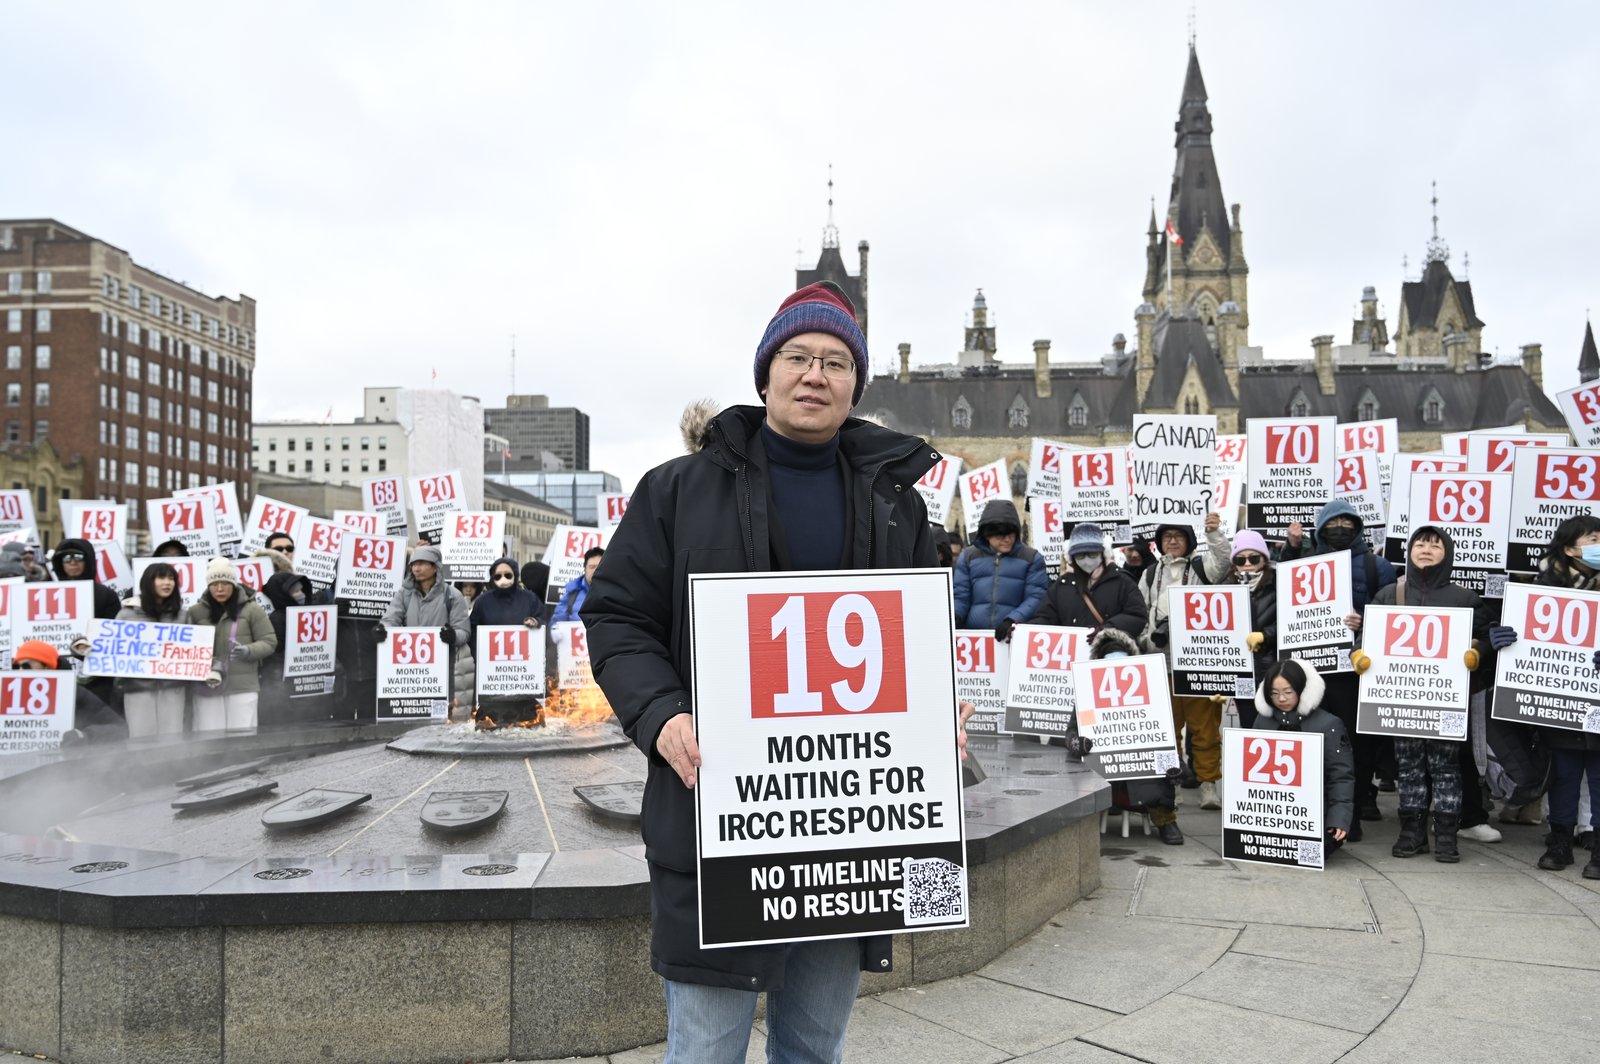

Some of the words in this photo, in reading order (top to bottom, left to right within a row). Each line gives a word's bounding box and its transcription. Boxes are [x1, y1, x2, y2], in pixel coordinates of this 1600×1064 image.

[1134, 422, 1216, 451] CANADA
[1272, 425, 1314, 464] 70
[1077, 453, 1108, 487] 13
[1134, 460, 1180, 486] WHAT
[1180, 463, 1212, 486] ARE
[1270, 468, 1312, 476] MONTHS
[1260, 480, 1300, 488] WAITING
[1304, 479, 1322, 487] FOR
[1542, 455, 1596, 500] 53
[422, 476, 451, 503] 20
[971, 470, 999, 501] 32
[374, 480, 396, 506] 68
[1078, 490, 1110, 498] MONTHS
[1254, 490, 1275, 499] IRCC
[1276, 490, 1328, 498] RESPONSE
[428, 503, 454, 511] MONTHS
[1070, 500, 1102, 508] WAITING
[1134, 493, 1158, 516] YOU
[1163, 490, 1212, 516] DOING?
[1436, 480, 1484, 522] 68
[166, 501, 198, 532] 27
[1084, 508, 1124, 518] RESPONSE
[1262, 506, 1274, 514] NO
[1539, 504, 1592, 516] MONTHS
[84, 511, 112, 540] 43
[263, 505, 290, 534] 31
[1266, 515, 1278, 523] NO
[459, 515, 490, 538] 36
[1516, 528, 1543, 539] IRCC
[313, 524, 342, 553] 39
[1472, 540, 1495, 550] FOR
[357, 540, 390, 569] 39
[1526, 546, 1540, 556] NO
[302, 560, 331, 570] WAITING
[355, 571, 386, 580] MONTHS
[346, 580, 378, 588] WAITING
[1295, 562, 1332, 604] 30
[34, 588, 70, 620] 11
[1190, 592, 1229, 630] 30
[1296, 606, 1332, 619] MONTHS
[32, 624, 72, 632] MONTHS
[300, 612, 324, 642] 39
[1288, 620, 1322, 632] WAITING
[1324, 617, 1342, 627] FOR
[1532, 596, 1590, 646] 90
[100, 620, 146, 640] STOP
[154, 624, 194, 642] THE
[1283, 635, 1301, 644] IRCC
[1302, 628, 1348, 642] RESPONSE
[1390, 614, 1443, 658] 20
[494, 632, 524, 660] 11
[1190, 636, 1230, 644] MONTHS
[300, 646, 324, 654] MONTHS
[396, 632, 431, 664] 36
[771, 592, 883, 714] 19
[957, 636, 990, 672] 31
[1031, 632, 1071, 670] 34
[1182, 646, 1220, 655] WAITING
[1222, 646, 1240, 656] FOR
[1302, 647, 1339, 658] TIMELINES
[1530, 646, 1586, 664] MONTHS
[293, 655, 317, 663] WAITING
[1177, 658, 1197, 666] IRCC
[1198, 658, 1246, 667] RESPONSE
[303, 662, 332, 672] RESPONSE
[1388, 662, 1440, 674] MONTHS
[1515, 658, 1570, 676] WAITING
[1574, 666, 1600, 680] FOR
[1029, 674, 1068, 684] MONTHS
[1198, 674, 1238, 682] TIMELINES
[1376, 675, 1425, 687] WAITING
[1428, 678, 1452, 688] FOR
[1506, 672, 1534, 685] IRCC
[984, 688, 1000, 697] FOR
[1019, 684, 1056, 694] WAITING
[1098, 665, 1144, 706] 42
[1190, 682, 1202, 690] NO
[1203, 683, 1236, 692] RESULTS
[6, 678, 50, 714] 18
[1012, 694, 1032, 704] IRCC
[1368, 688, 1393, 698] IRCC
[1395, 689, 1460, 702] RESPONSE
[1516, 692, 1532, 704] NO
[1534, 694, 1592, 711] TIMELINES
[1020, 710, 1031, 718] NO
[1032, 711, 1072, 722] TIMELINES
[1102, 709, 1146, 721] MONTHS
[1378, 706, 1392, 716] NO
[1520, 705, 1535, 716] NO
[1538, 707, 1584, 723] RESULTS
[4, 720, 49, 728] MONTHS
[1022, 720, 1033, 728] NO
[1034, 722, 1068, 732] RESULTS
[1092, 722, 1136, 734] WAITING
[1140, 720, 1160, 730] FOR
[1381, 718, 1396, 728] NO
[1397, 718, 1440, 730] RESULTS
[40, 730, 60, 738] FOR
[1112, 732, 1168, 746] RESPONSE
[768, 730, 892, 764] MONTHS
[1100, 754, 1113, 764] NO
[1248, 738, 1296, 785] 25
[1105, 764, 1118, 774] NO
[1120, 762, 1156, 772] RESULTS
[736, 768, 860, 802] WAITING
[870, 766, 924, 796] FOR
[1248, 788, 1295, 802] MONTHS
[1236, 801, 1282, 814] WAITING
[1286, 806, 1308, 818] FOR
[719, 810, 784, 842] IRCC
[790, 801, 944, 838] RESPONSE
[1230, 814, 1254, 826] IRCC
[1255, 816, 1314, 832] RESPONSE
[1240, 834, 1254, 844] NO
[1244, 845, 1258, 855] NO
[1259, 847, 1298, 860] RESULTS
[751, 865, 785, 891] NO
[762, 896, 797, 922] NO
[804, 888, 905, 919] RESULTS
